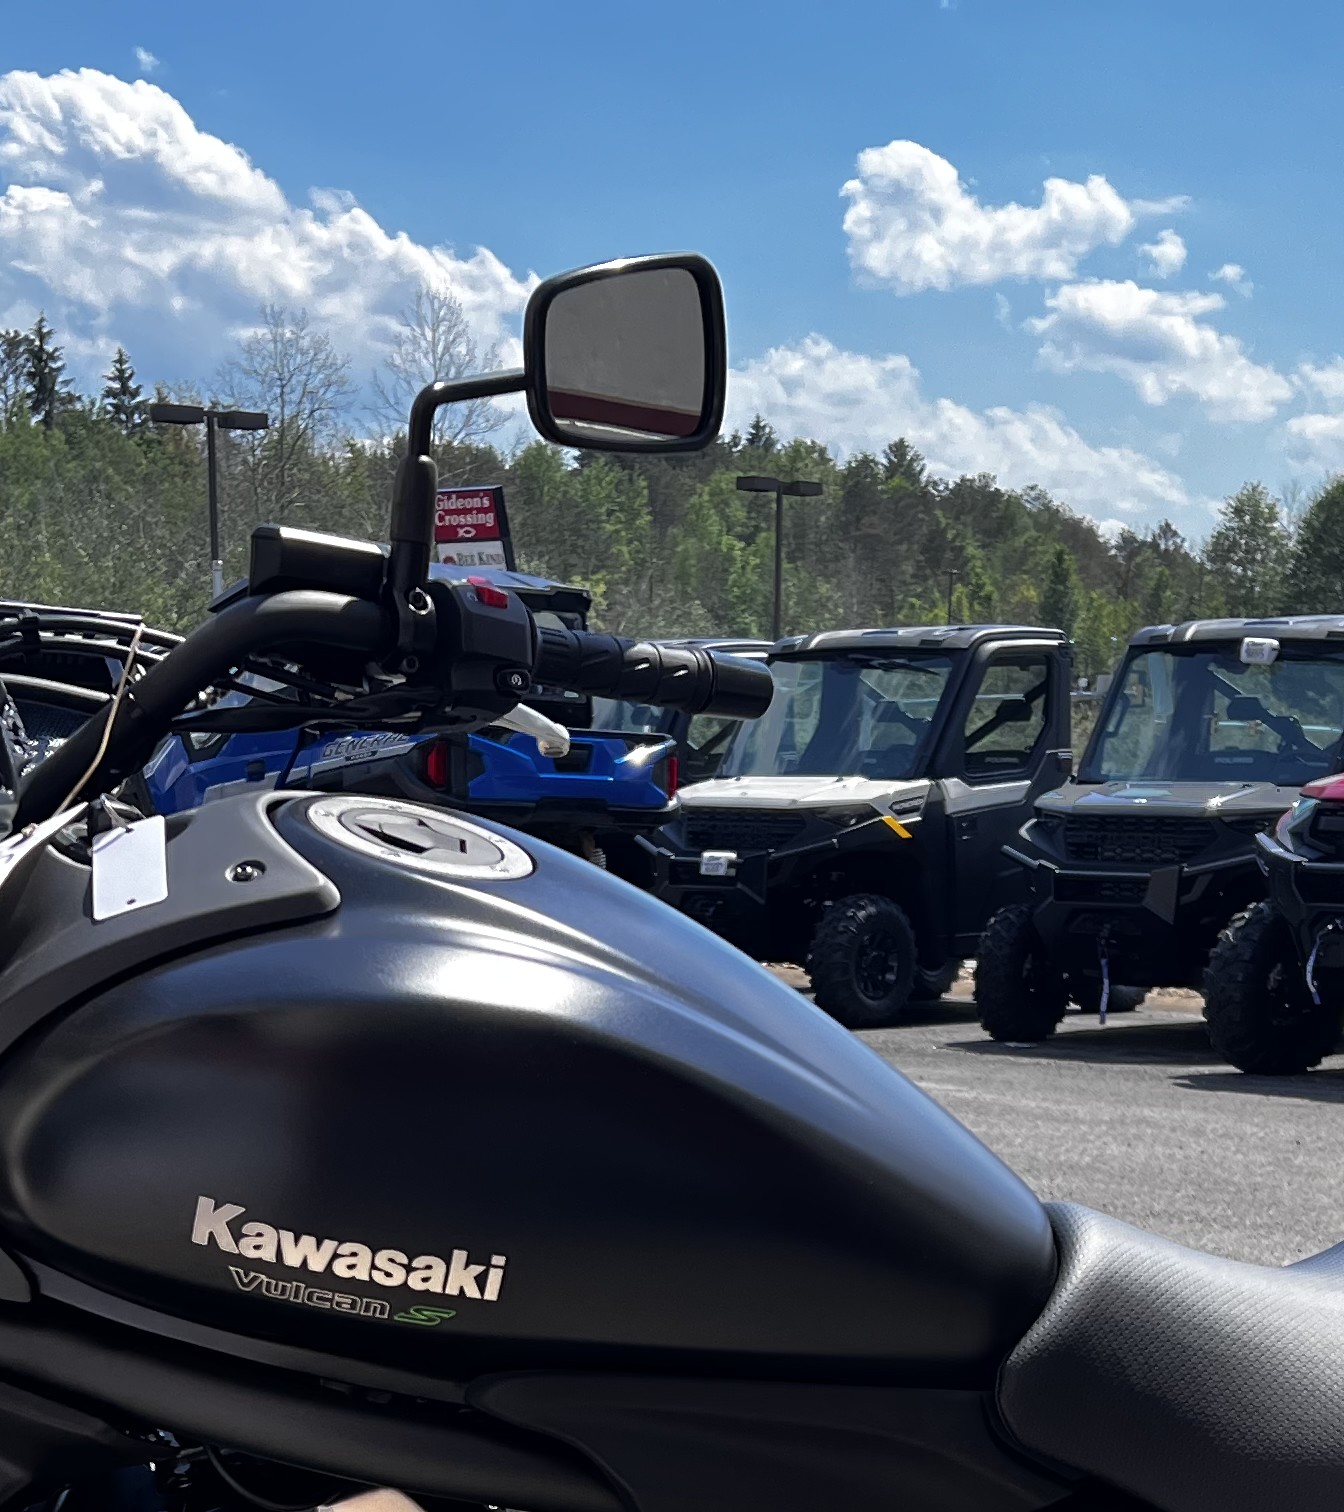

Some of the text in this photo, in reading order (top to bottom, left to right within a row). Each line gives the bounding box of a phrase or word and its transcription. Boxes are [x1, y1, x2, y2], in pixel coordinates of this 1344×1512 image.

[435, 493, 490, 511] Gideon's
[435, 510, 495, 527] Crossing
[191, 1195, 506, 1301] Kawasaki
[228, 1265, 456, 1326] Vulcan S
